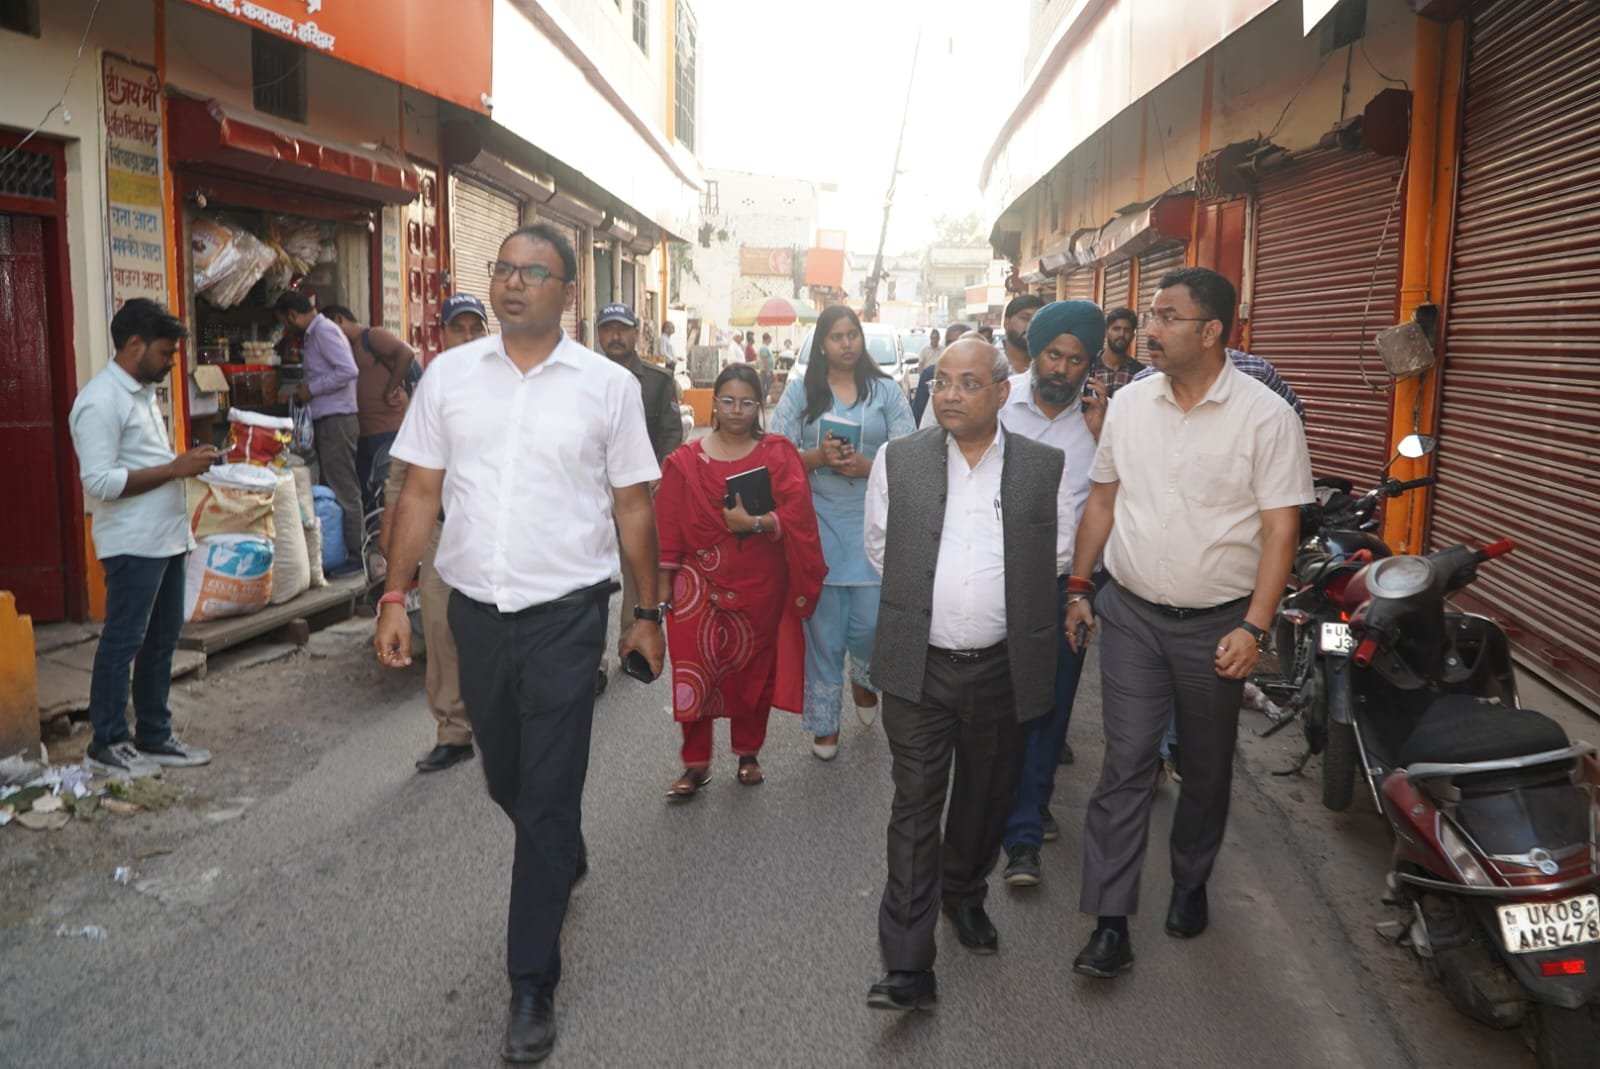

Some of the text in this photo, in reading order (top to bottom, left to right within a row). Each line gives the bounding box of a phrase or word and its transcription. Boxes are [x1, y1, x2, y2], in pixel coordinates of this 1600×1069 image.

[109, 78, 141, 108] जय
[112, 206, 157, 232] चना आटा
[141, 243, 161, 262] आटा
[141, 270, 163, 291] आटा
[1527, 900, 1583, 925] UK08
[1520, 920, 1600, 949] AM9478
